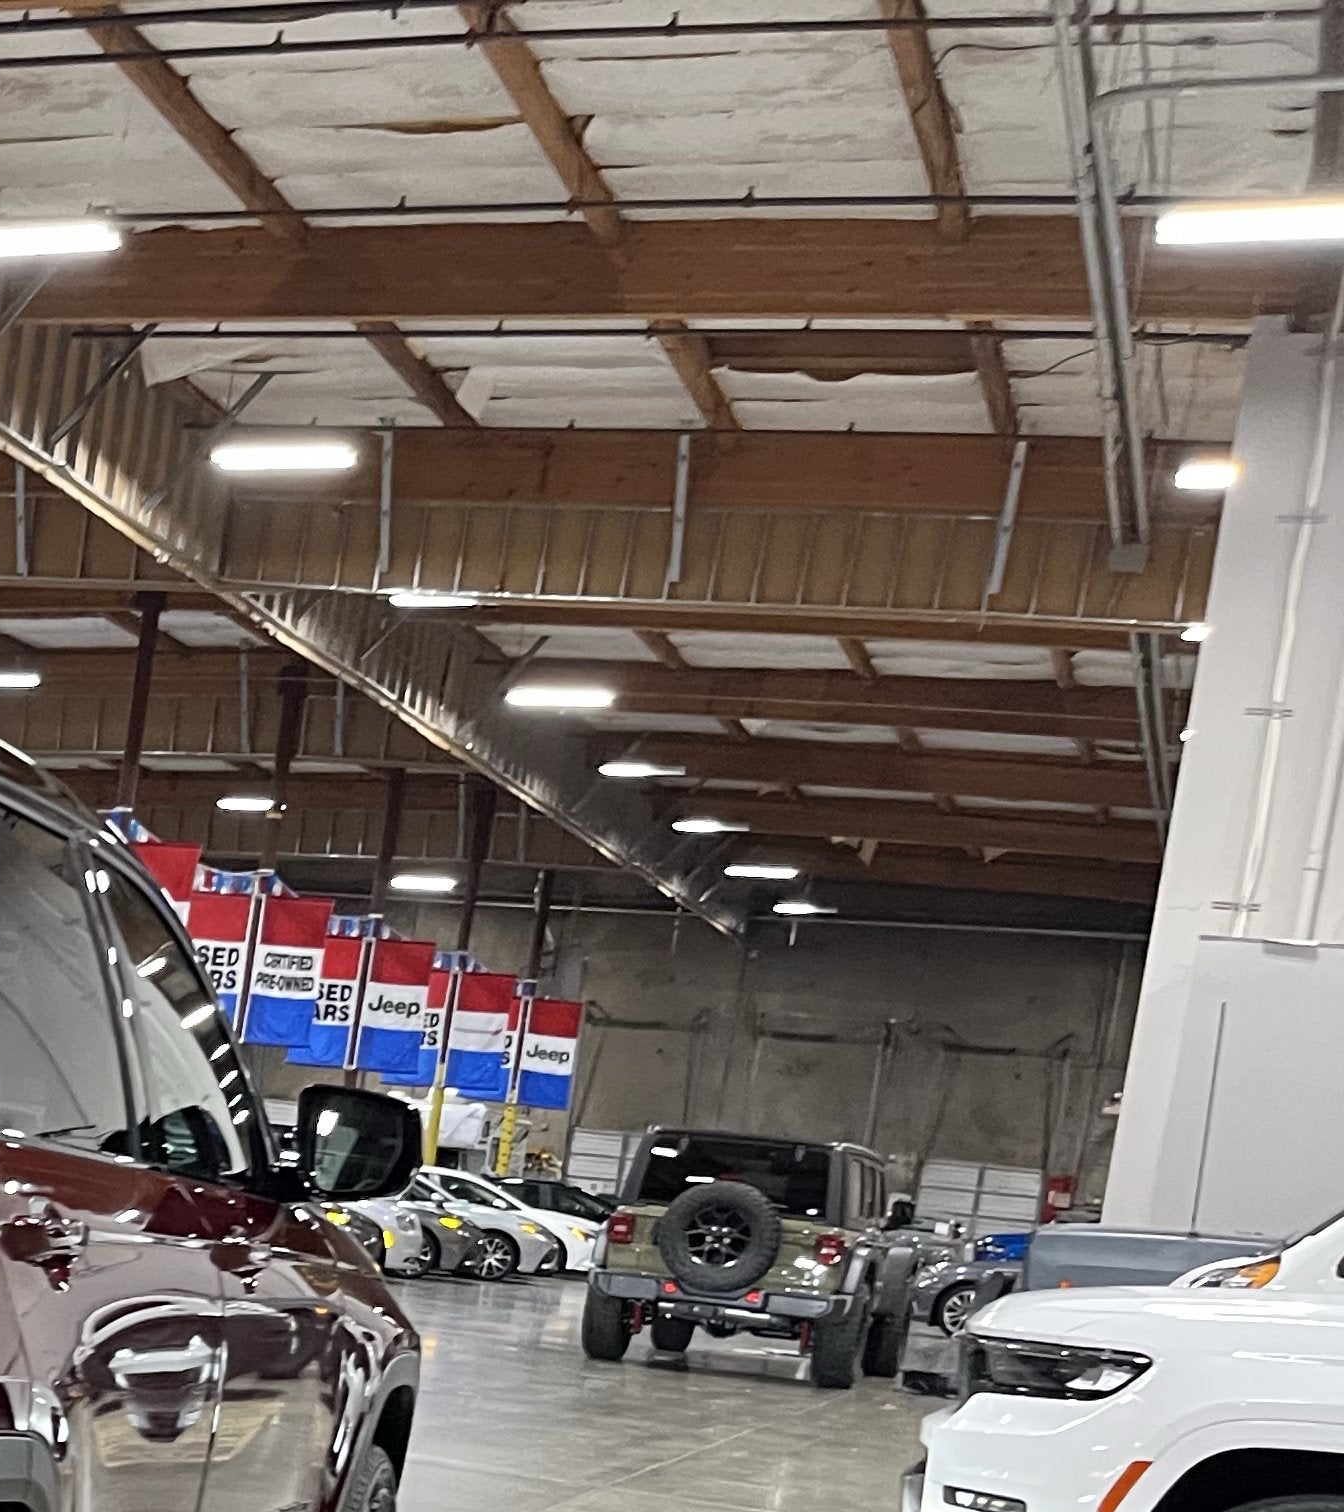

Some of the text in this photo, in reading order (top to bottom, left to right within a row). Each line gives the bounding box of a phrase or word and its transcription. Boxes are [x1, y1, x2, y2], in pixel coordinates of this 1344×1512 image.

[195, 945, 239, 967] SED
[317, 983, 352, 1001] SED
[314, 1003, 349, 1021] ARS
[368, 994, 420, 1018] Jeep
[526, 1044, 570, 1064] Jeep
